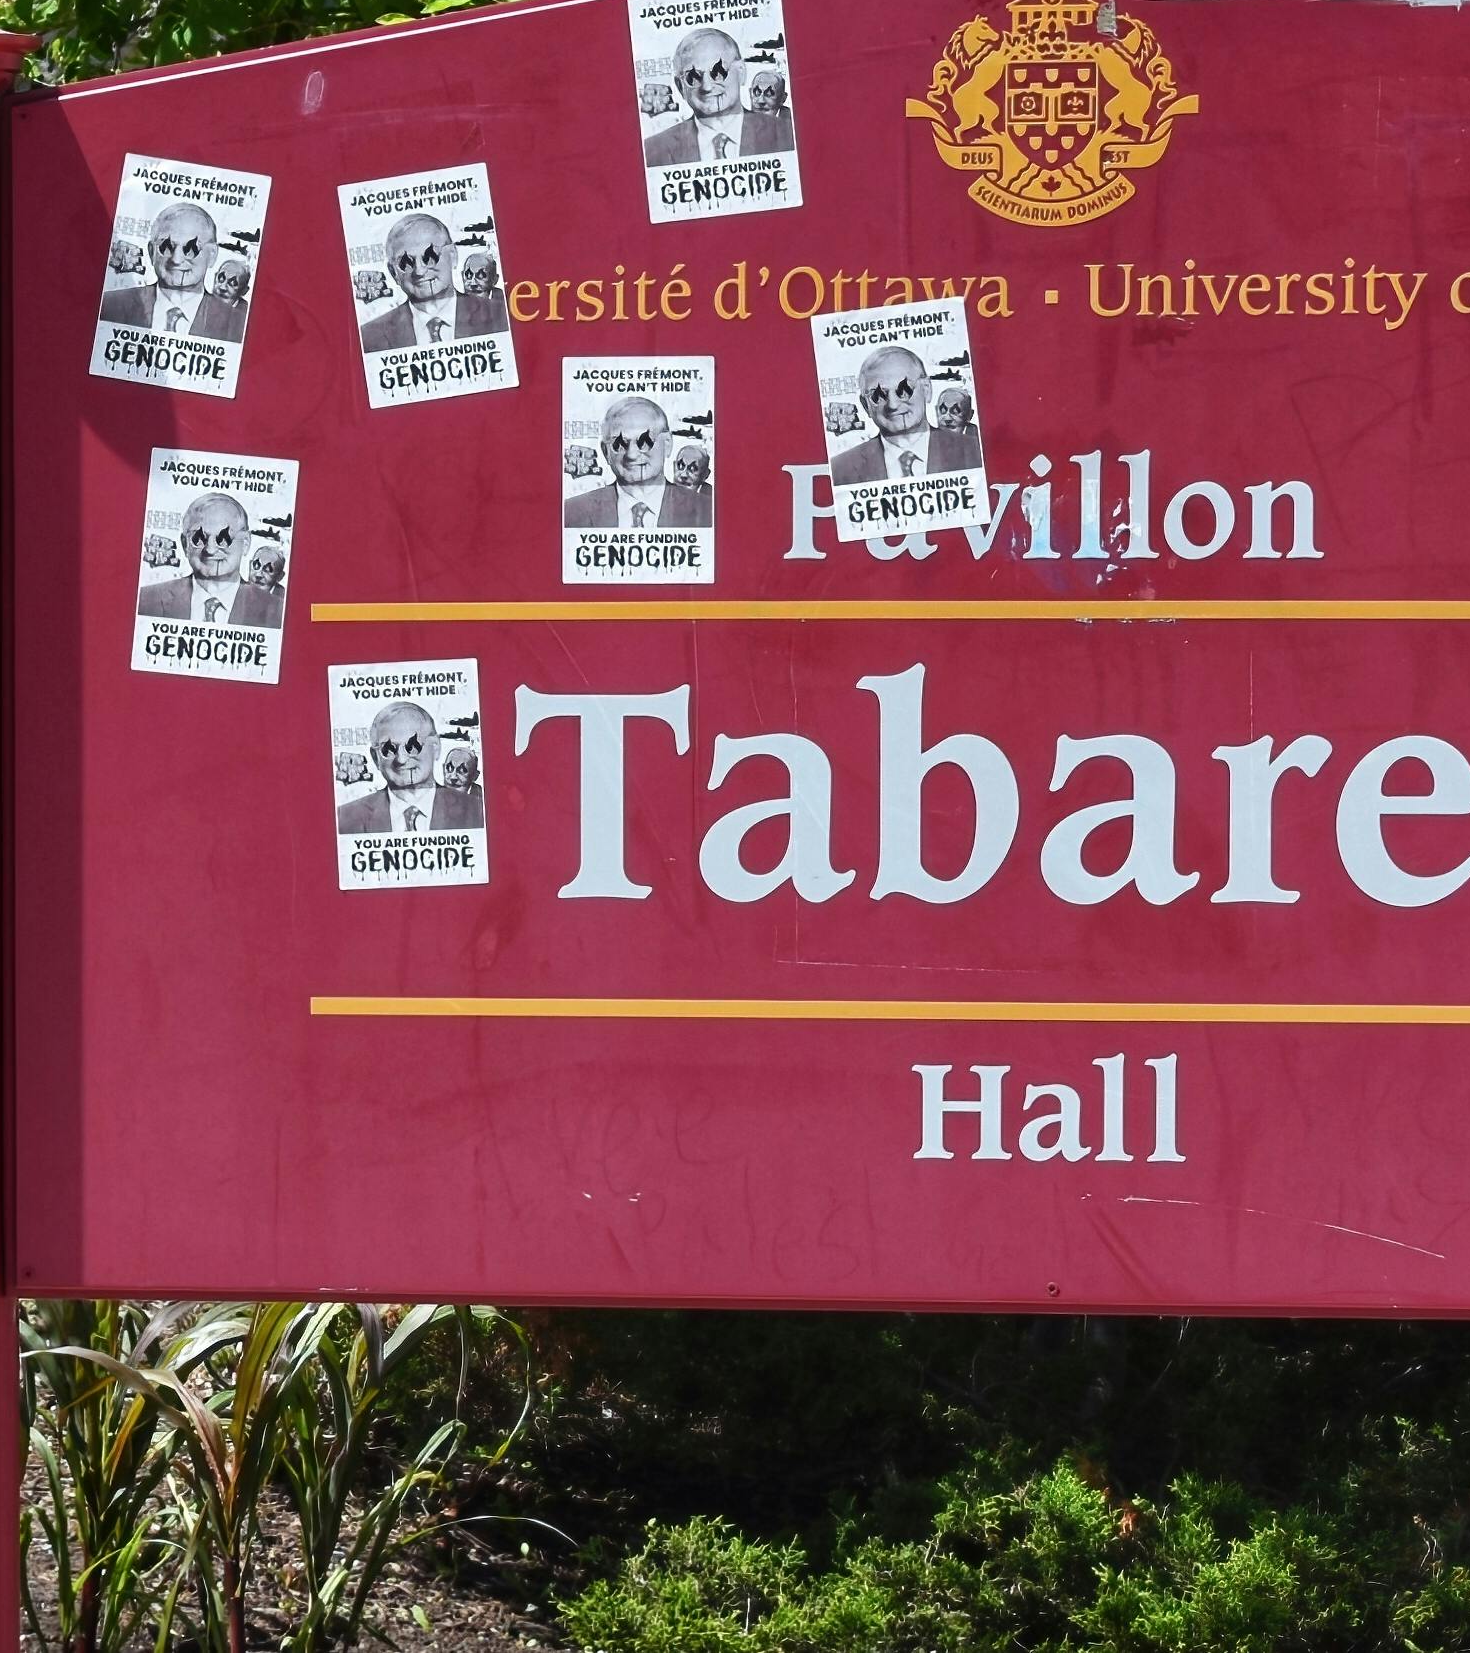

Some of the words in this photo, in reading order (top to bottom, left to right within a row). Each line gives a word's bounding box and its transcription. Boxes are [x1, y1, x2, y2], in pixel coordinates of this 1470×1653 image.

[638, 1, 701, 19] JACQUES
[653, 16, 682, 30] YOU
[683, 11, 726, 26] CAN'T
[728, 6, 759, 20] HIDE
[662, 168, 692, 182] YOU
[693, 165, 720, 178] ARE
[721, 157, 781, 175] FUNDING
[961, 151, 994, 166] DEUS
[131, 166, 193, 187] JACQUES
[659, 168, 789, 207] GENOCIDE
[142, 181, 171, 196] YOU
[172, 186, 214, 203] CAN'T
[214, 192, 245, 207] HIDE
[348, 187, 411, 207] JACQUES
[364, 203, 392, 217] YOU
[393, 196, 436, 212] CAN'T
[437, 190, 468, 205] HIDE
[975, 185, 1063, 222] SCIENTIARUM
[1066, 182, 1128, 220] DOMINUS
[507, 263, 692, 322] ersité
[1084, 257, 1428, 330] University
[822, 319, 885, 338] JACQUES
[837, 335, 866, 349] YOU
[867, 329, 911, 344] CAN'T
[912, 324, 944, 338] HIDE
[111, 328, 140, 342] YOU
[140, 333, 167, 346] ARE
[167, 337, 226, 357] FUNDING
[379, 353, 409, 367] YOU
[409, 348, 436, 362] ARE
[437, 338, 496, 358] FUNDING
[103, 338, 228, 382] GENOCIDE
[377, 349, 505, 392] GENOCIDE
[573, 369, 634, 381] JACQUES
[586, 383, 614, 393] YOU
[616, 382, 659, 393] CAN'T
[661, 382, 691, 392] HIDE
[159, 460, 220, 477] JACQUES
[171, 474, 199, 487] YOU
[201, 477, 242, 491] CAN'T
[244, 480, 274, 493] HIDE
[849, 486, 879, 500] YOU
[880, 483, 907, 496] ARE
[908, 474, 969, 493] FUNDING
[847, 485, 977, 526] GENOCIDE
[579, 534, 608, 544] YOU
[610, 534, 636, 543] ARE
[638, 533, 697, 544] FUNDING
[575, 545, 702, 569] GENOCIDE
[150, 622, 179, 635] YOU
[180, 625, 206, 637] ARE
[207, 627, 266, 643] FUNDING
[144, 632, 269, 669] GENOCIDE
[338, 674, 399, 688] JACQUES
[352, 688, 380, 700] YOU
[382, 686, 424, 698] CAN'T
[425, 684, 456, 696] HIDE
[353, 838, 382, 849] YOU
[384, 837, 409, 848] ARE
[411, 834, 470, 847] FUNDING
[350, 845, 476, 875] GENOCIDE
[911, 1052, 1187, 1163] Hall
